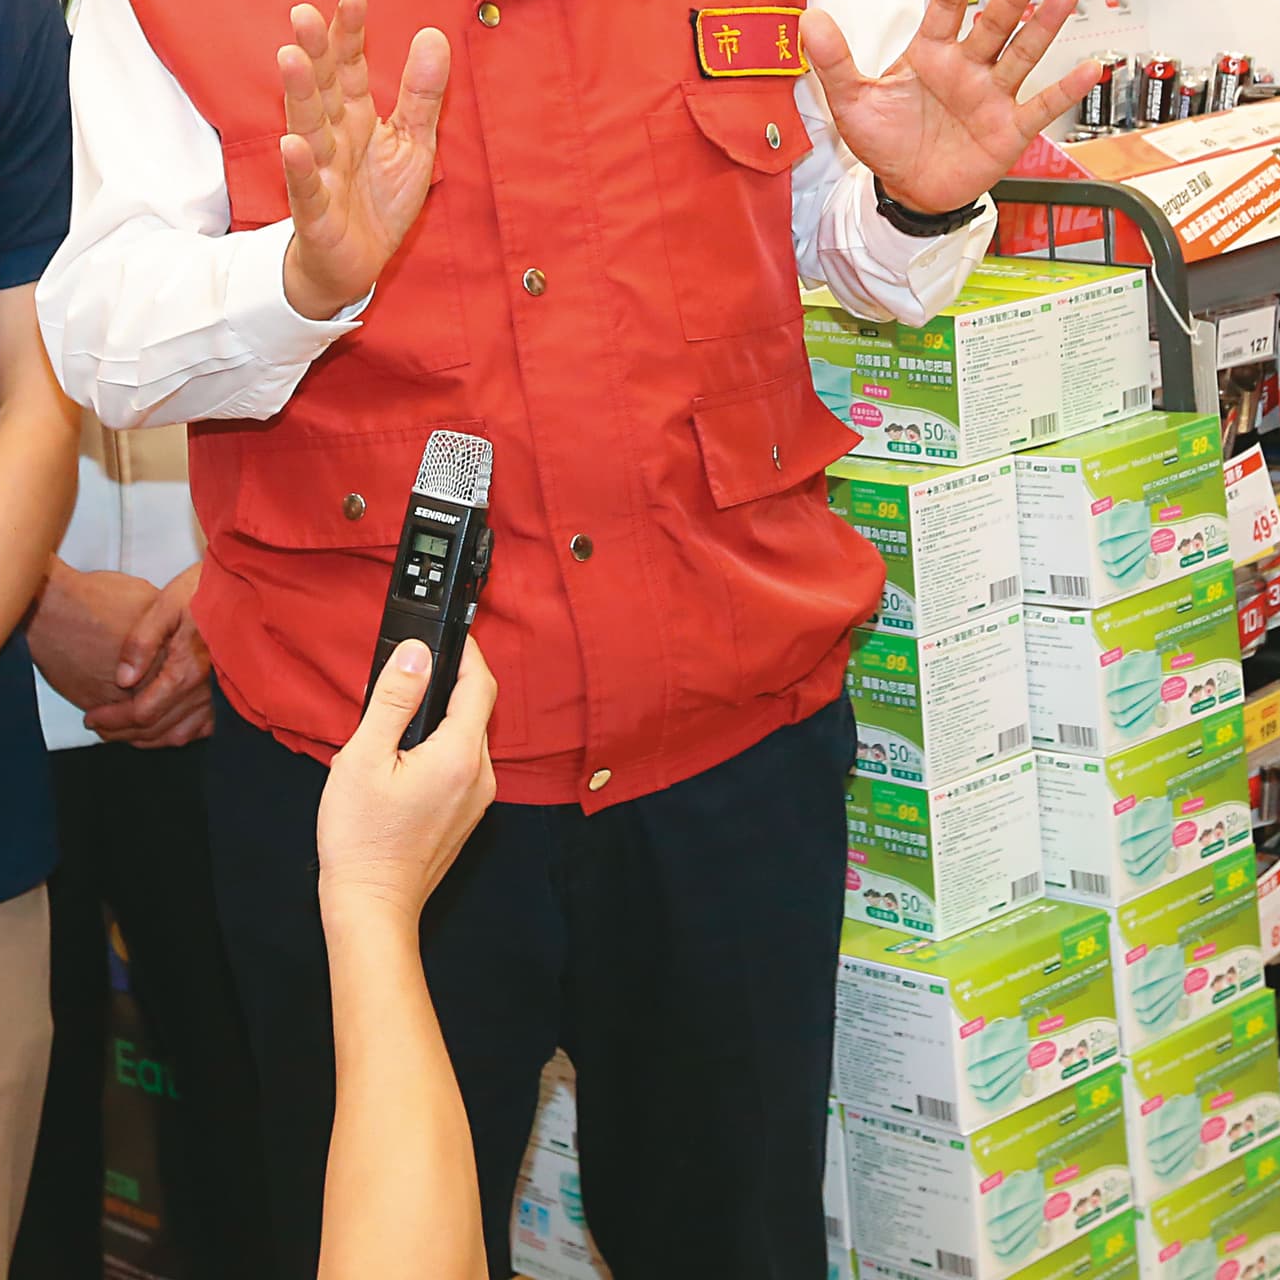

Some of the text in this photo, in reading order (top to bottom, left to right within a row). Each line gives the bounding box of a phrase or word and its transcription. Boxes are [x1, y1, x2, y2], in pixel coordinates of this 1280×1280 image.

[712, 23, 793, 65] 市長
[1250, 336, 1268, 354] 127
[924, 422, 944, 441] 50
[414, 506, 456, 525] SENRUN
[1251, 508, 1279, 543] 49.5
[888, 743, 909, 763] 50
[900, 892, 921, 913] 50
